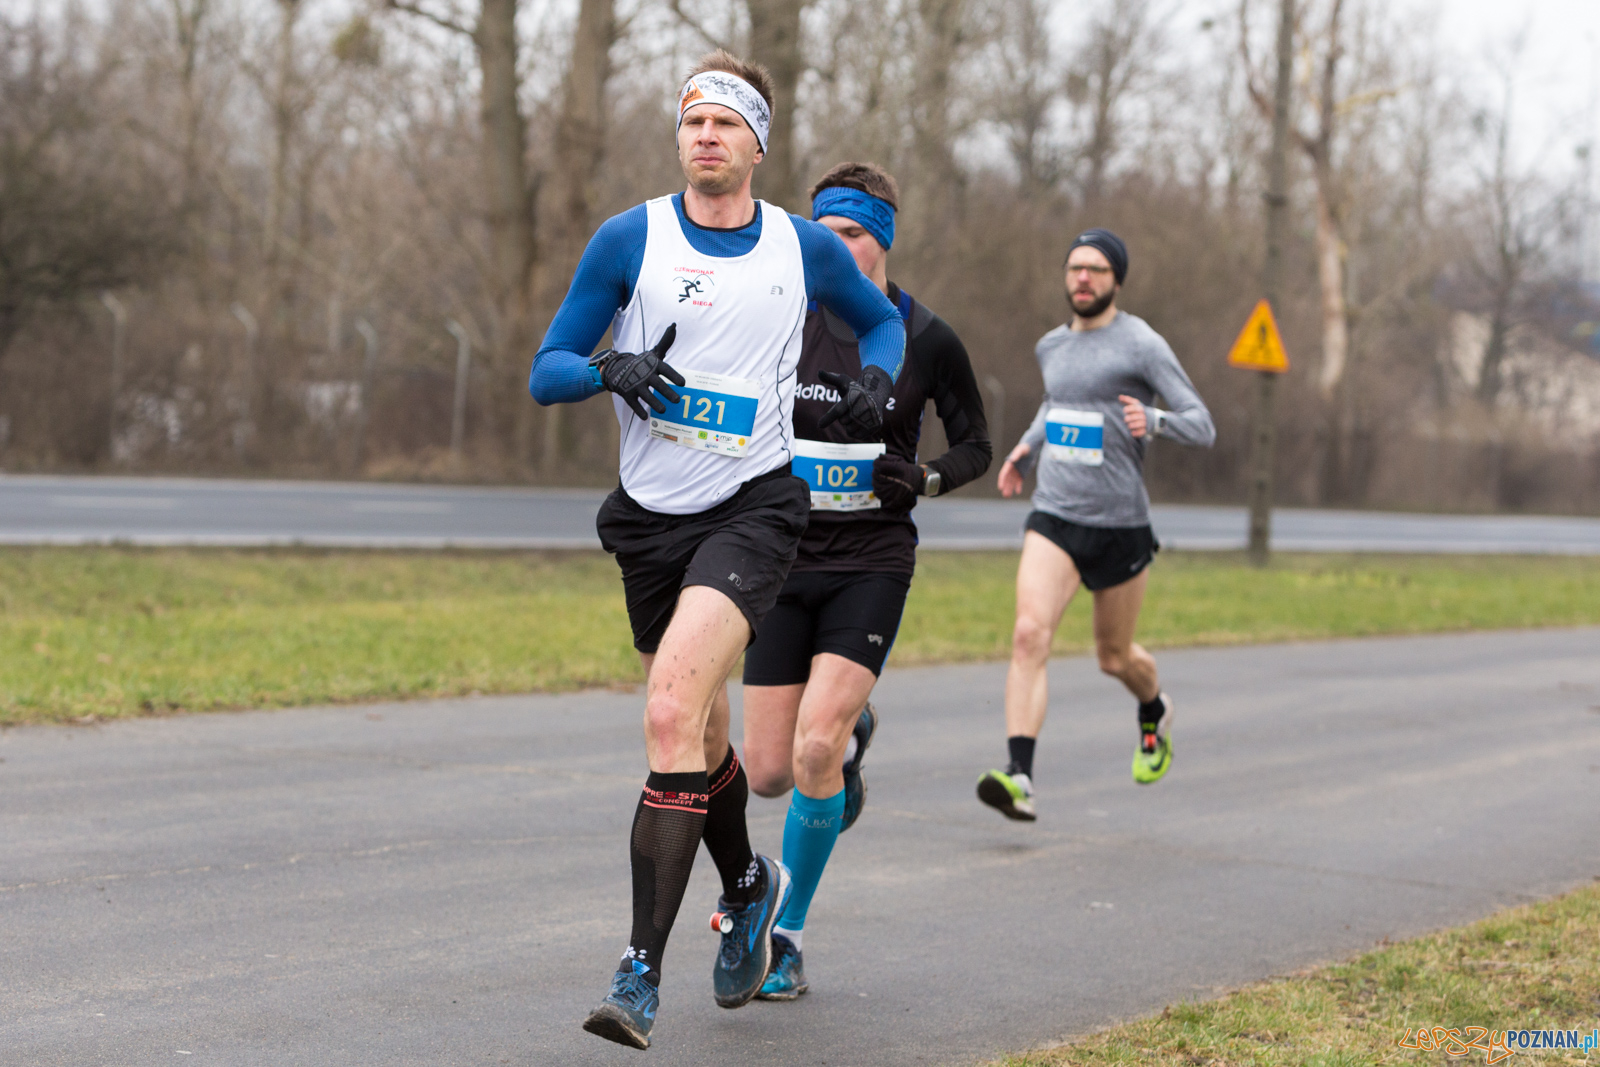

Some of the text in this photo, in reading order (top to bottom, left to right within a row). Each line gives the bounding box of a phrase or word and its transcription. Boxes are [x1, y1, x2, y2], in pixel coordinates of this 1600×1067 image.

[674, 266, 715, 275] CZERWONAK
[681, 394, 726, 426] 121
[1061, 426, 1081, 445] 77
[814, 464, 859, 488] 102
[658, 798, 693, 806] CONCEPT
